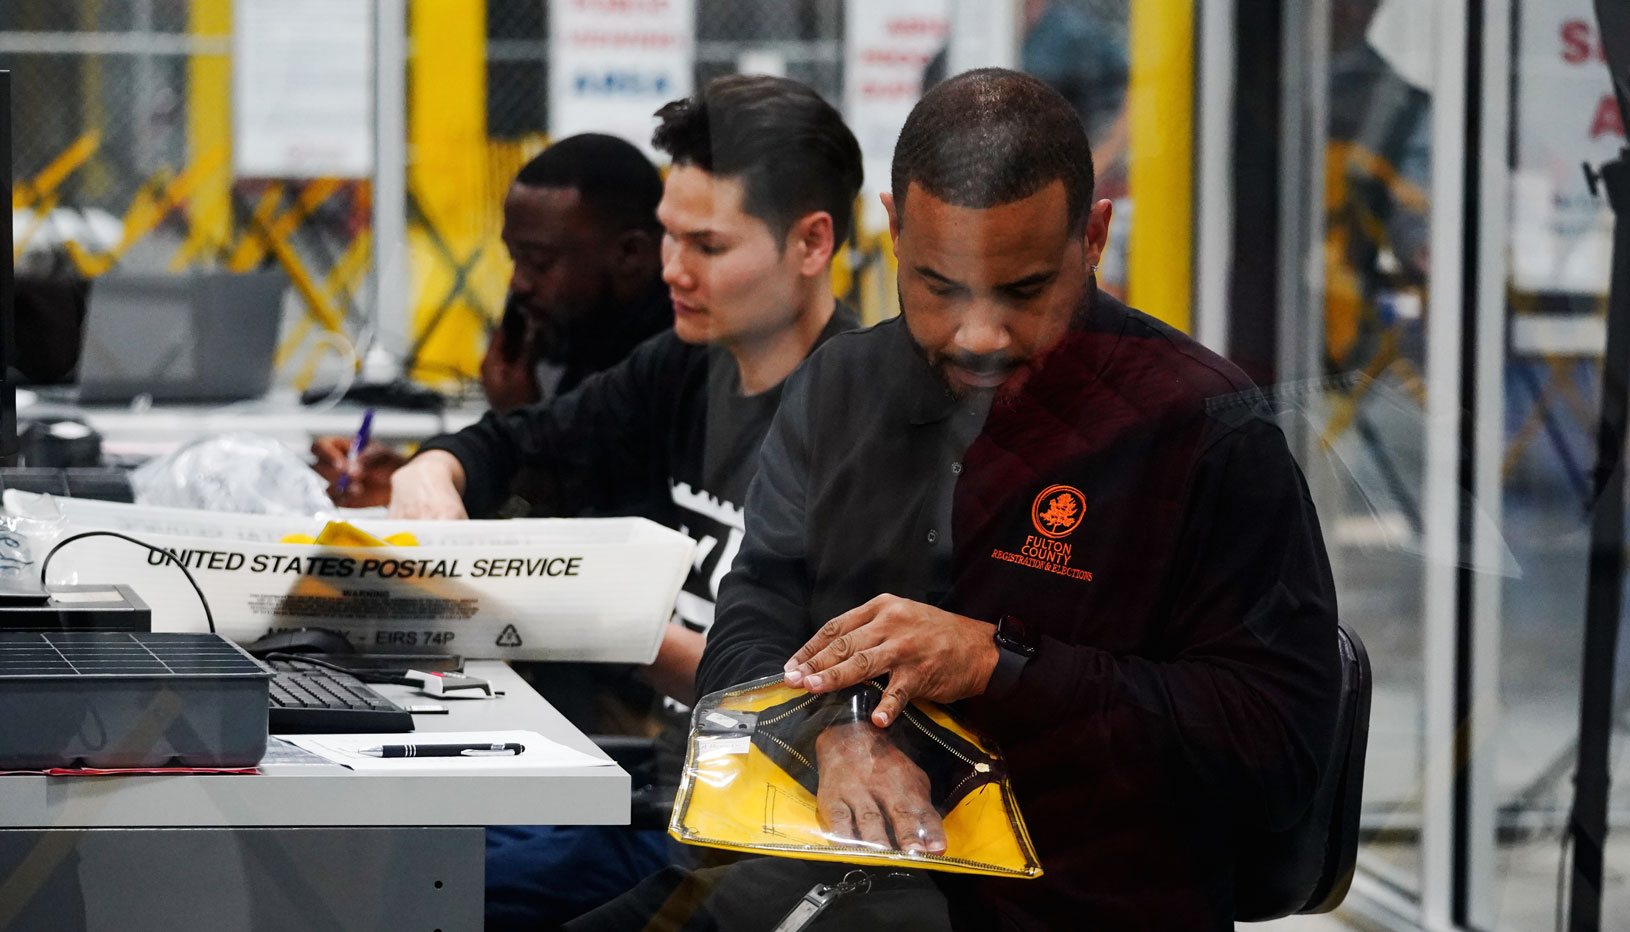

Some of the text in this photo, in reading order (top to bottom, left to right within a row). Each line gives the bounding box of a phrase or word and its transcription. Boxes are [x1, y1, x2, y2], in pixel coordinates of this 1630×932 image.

[1025, 535, 1072, 555] FULTON
[147, 547, 583, 578] UNITED STATES POSTAL SERVICE
[991, 548, 1045, 570] REGISTRATION
[1051, 563, 1093, 582] ELECTIONS
[1021, 545, 1072, 566] COUNTY
[342, 590, 389, 598] WARNING
[375, 631, 418, 645] EIRS
[423, 631, 455, 645] 74P
